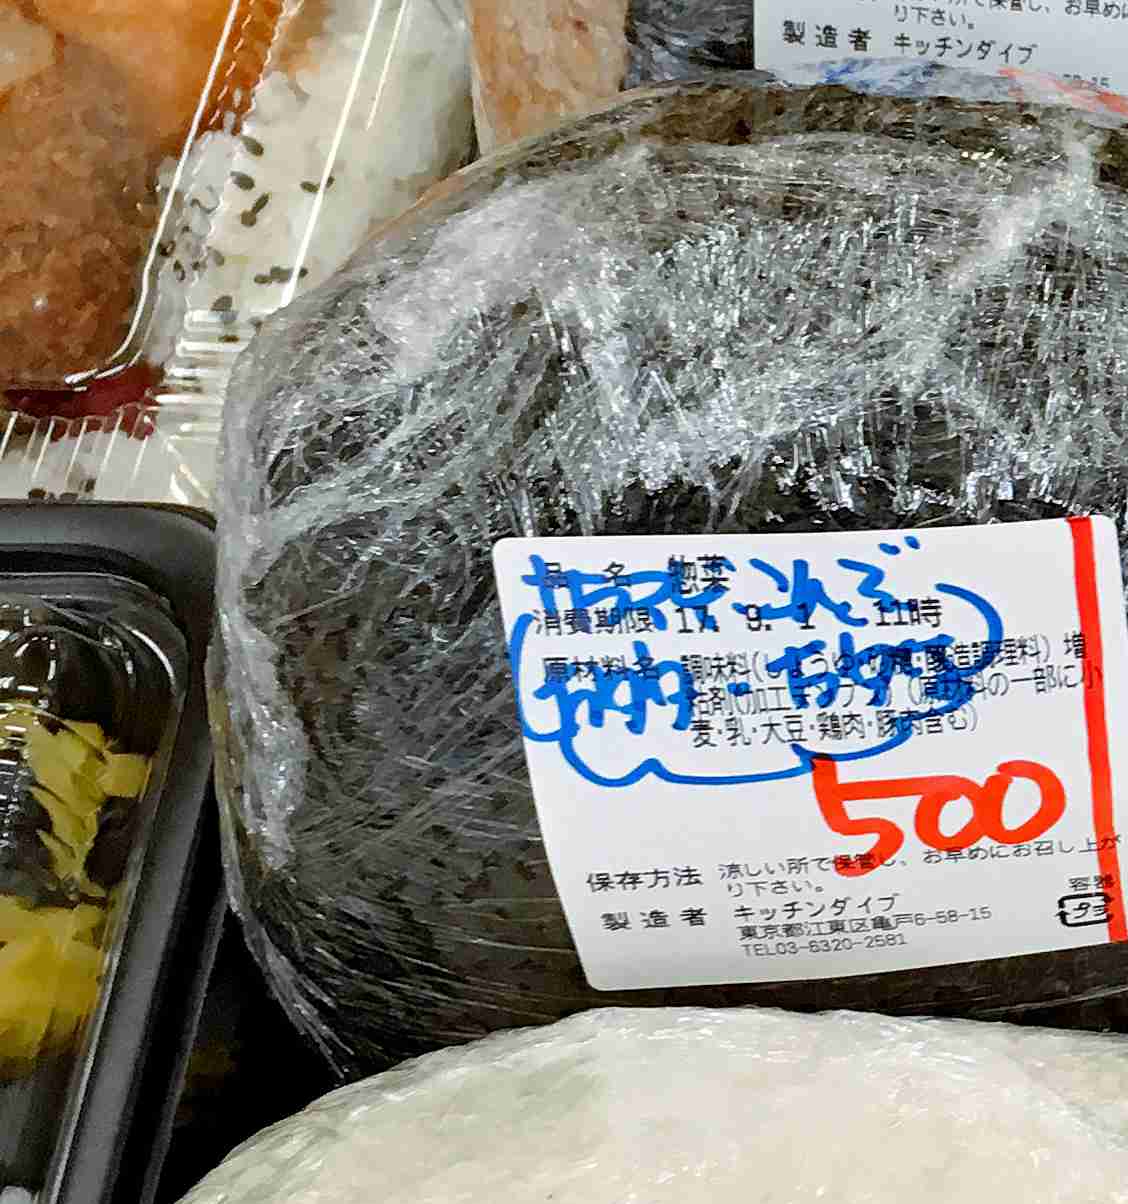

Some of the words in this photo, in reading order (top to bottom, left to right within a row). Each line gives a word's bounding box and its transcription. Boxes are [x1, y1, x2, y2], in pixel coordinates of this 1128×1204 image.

[894, 5, 976, 30] り下さい。
[893, 33, 1038, 65] キッチンダイブ
[812, 754, 1066, 876] 500
[587, 866, 703, 892] 保存方法
[727, 880, 825, 898] り下さい。
[734, 892, 900, 921] キッチンダイブ
